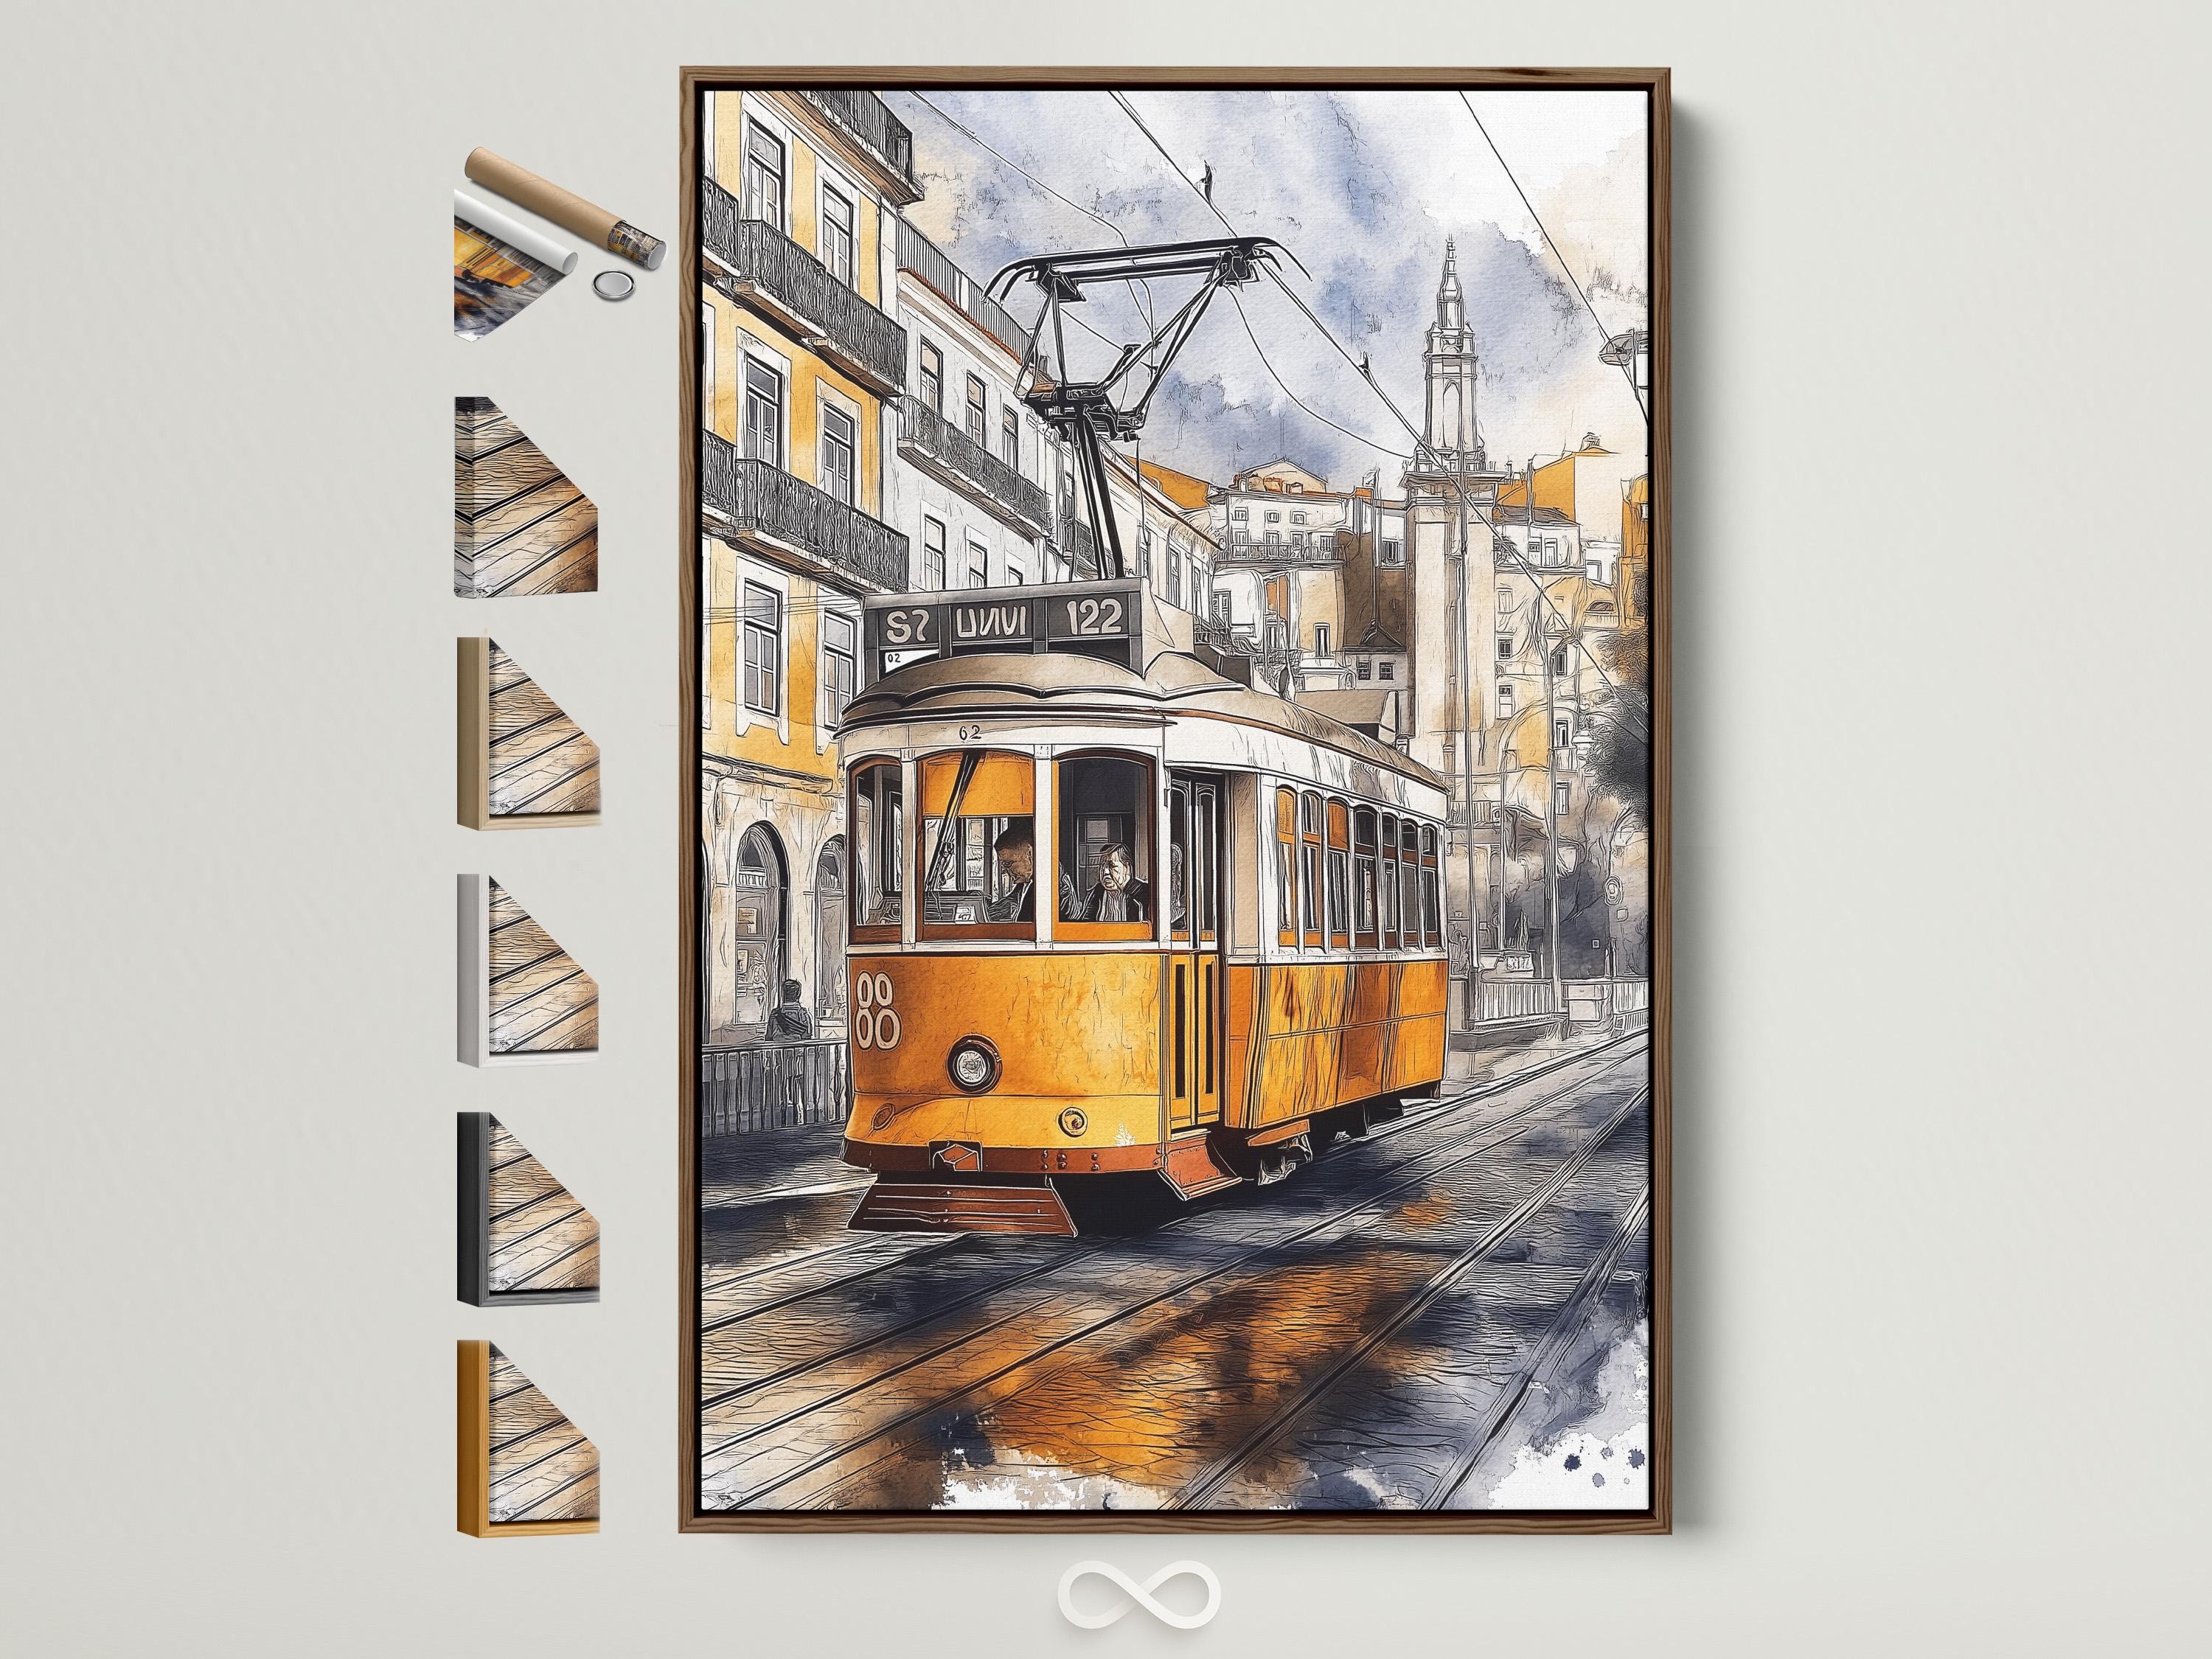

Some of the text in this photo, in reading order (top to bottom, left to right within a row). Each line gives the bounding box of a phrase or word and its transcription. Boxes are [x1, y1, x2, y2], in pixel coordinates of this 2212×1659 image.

[1067, 599, 1122, 635] 122
[888, 653, 901, 663] 02
[959, 724, 981, 740] 62
